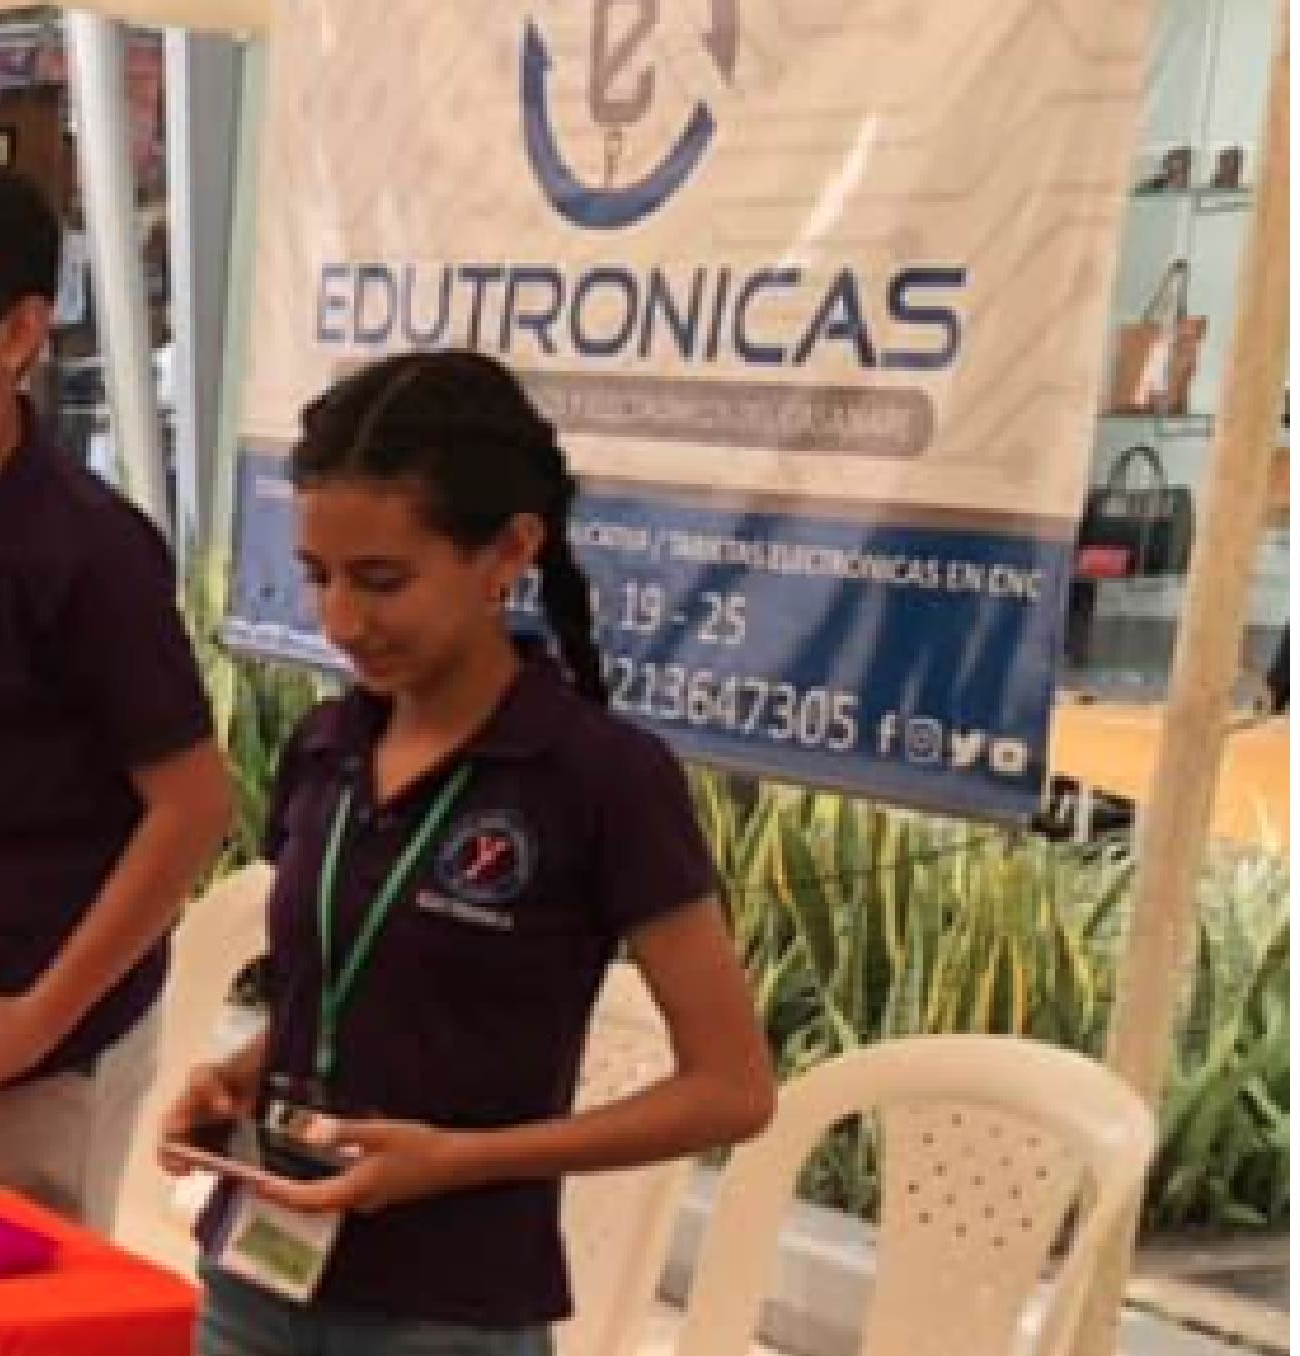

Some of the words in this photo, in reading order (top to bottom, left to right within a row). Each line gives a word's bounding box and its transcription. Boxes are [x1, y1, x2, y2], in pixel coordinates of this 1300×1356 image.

[315, 262, 967, 370] EDUTRONICAS
[618, 578, 665, 635] 19
[697, 590, 747, 646] 25
[948, 559, 981, 592] EN
[989, 564, 1043, 606] CNC
[603, 652, 861, 751] 213647305
